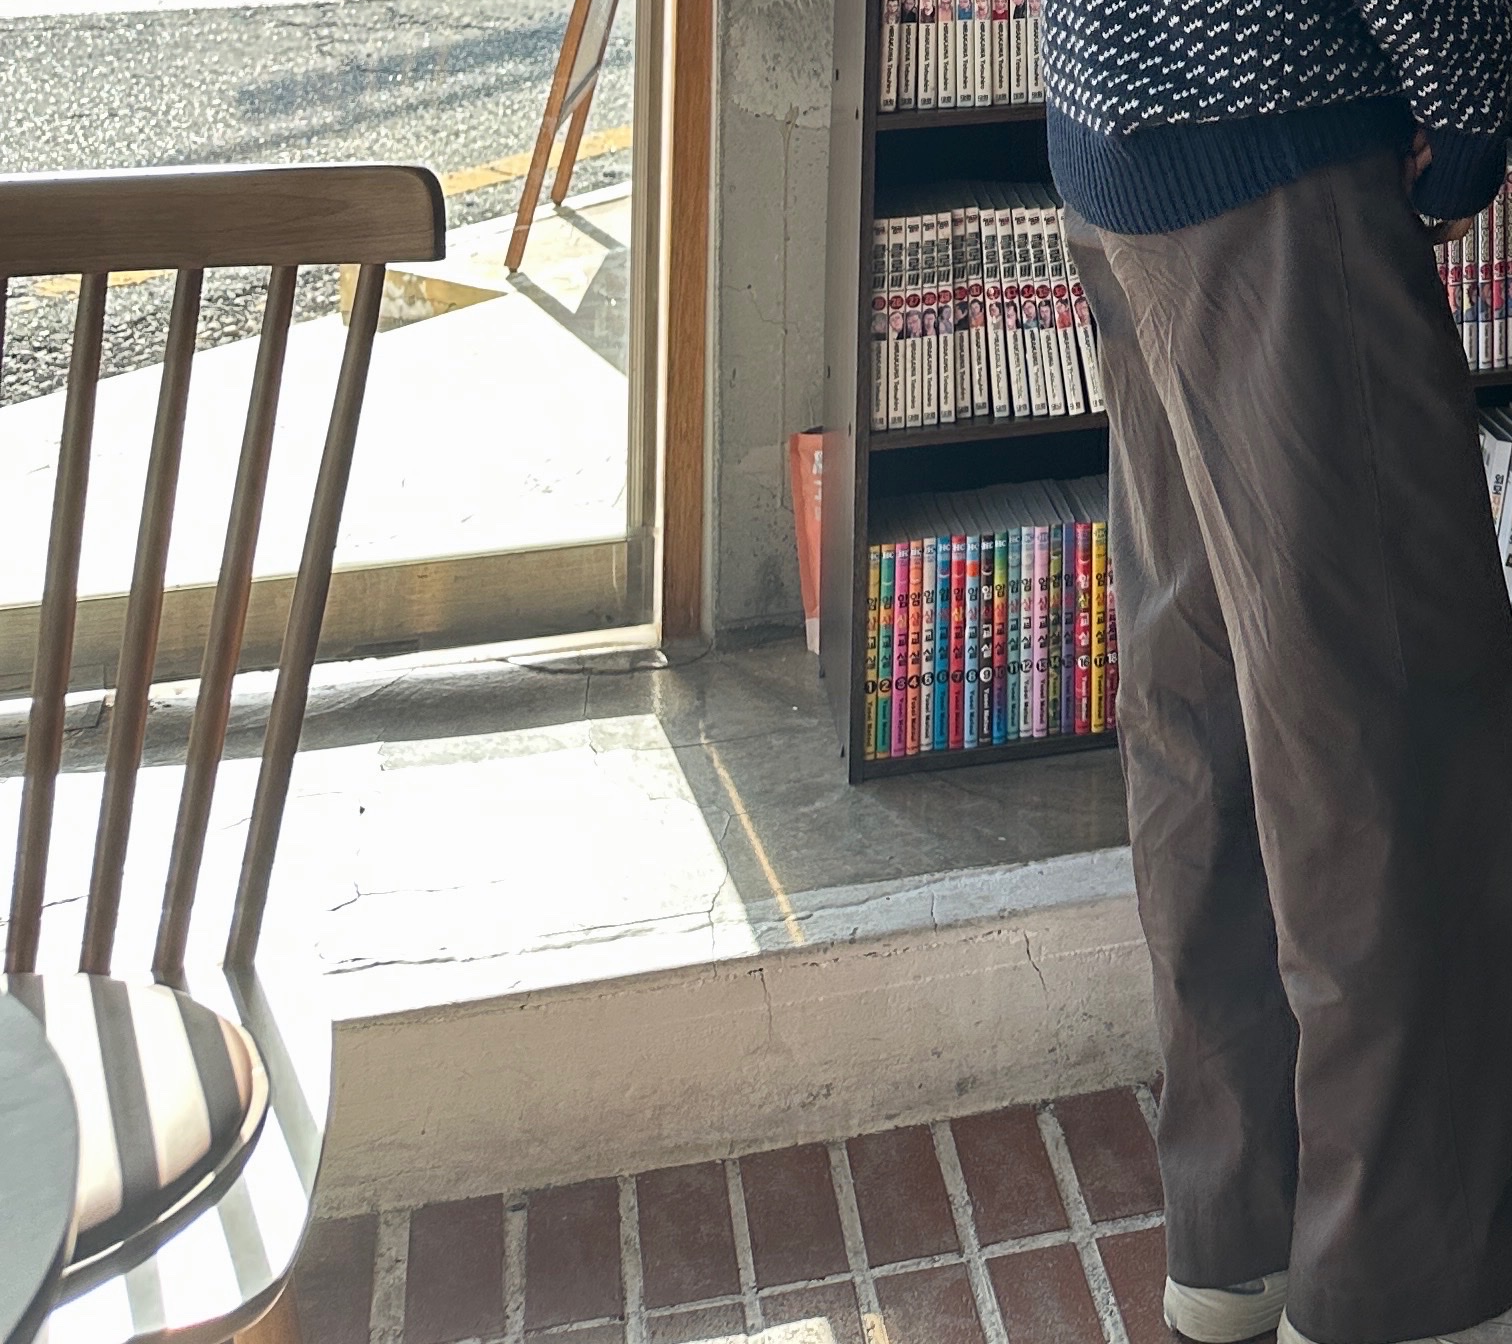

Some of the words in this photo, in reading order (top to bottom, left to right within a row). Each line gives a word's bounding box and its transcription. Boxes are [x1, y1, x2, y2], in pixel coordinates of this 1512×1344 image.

[866, 598, 878, 669] 암살교실
[881, 595, 893, 668] 암살교실
[897, 594, 908, 666] 암살교실
[910, 592, 921, 665] 암살교실
[923, 590, 934, 662] 암살교실
[938, 589, 949, 661] 암살교실
[953, 589, 964, 661] 암살교실
[967, 587, 978, 660] 암살교실
[982, 585, 993, 659] 암살교실
[995, 584, 1005, 656] 암살교실
[1009, 580, 1019, 651] 암살교실
[1022, 578, 1031, 650] 암살교실
[1038, 578, 1048, 649] 암살교실
[1078, 574, 1089, 646] 암살교실
[1096, 573, 1106, 644] 암살교실
